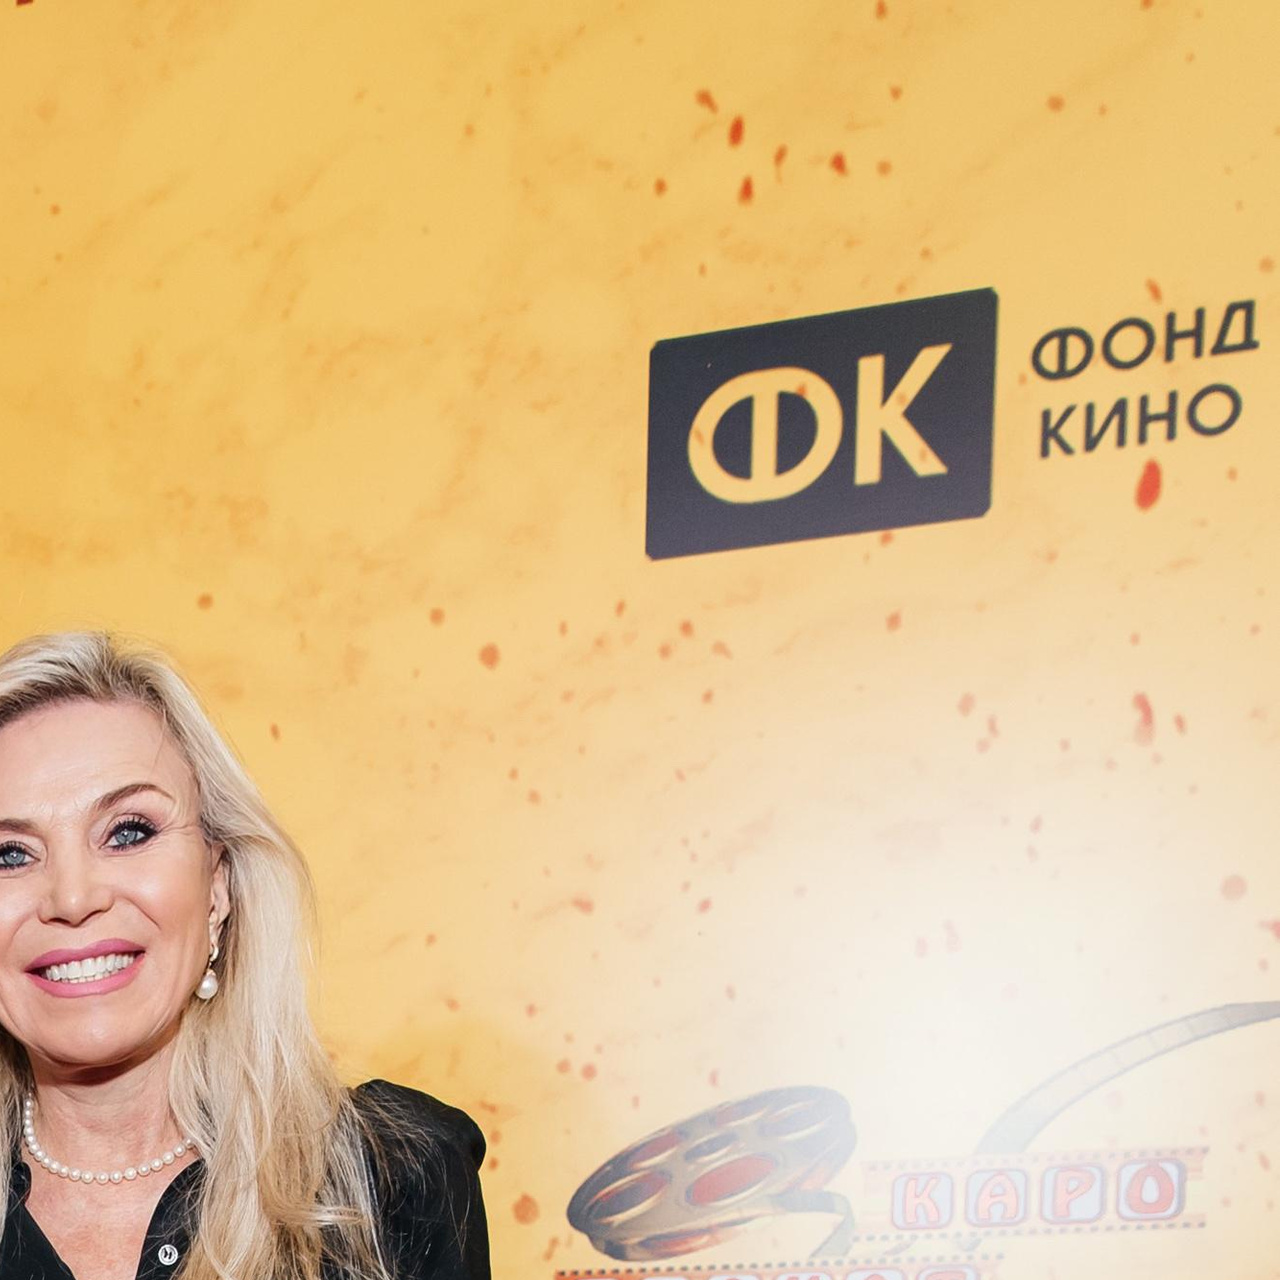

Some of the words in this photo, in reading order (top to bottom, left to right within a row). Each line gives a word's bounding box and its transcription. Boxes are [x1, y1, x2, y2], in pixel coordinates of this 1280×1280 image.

[1031, 300, 1260, 381] ФОНД
[687, 343, 954, 503] ФК
[1039, 383, 1243, 459] КИНО
[900, 1160, 1176, 1225] КАРО
